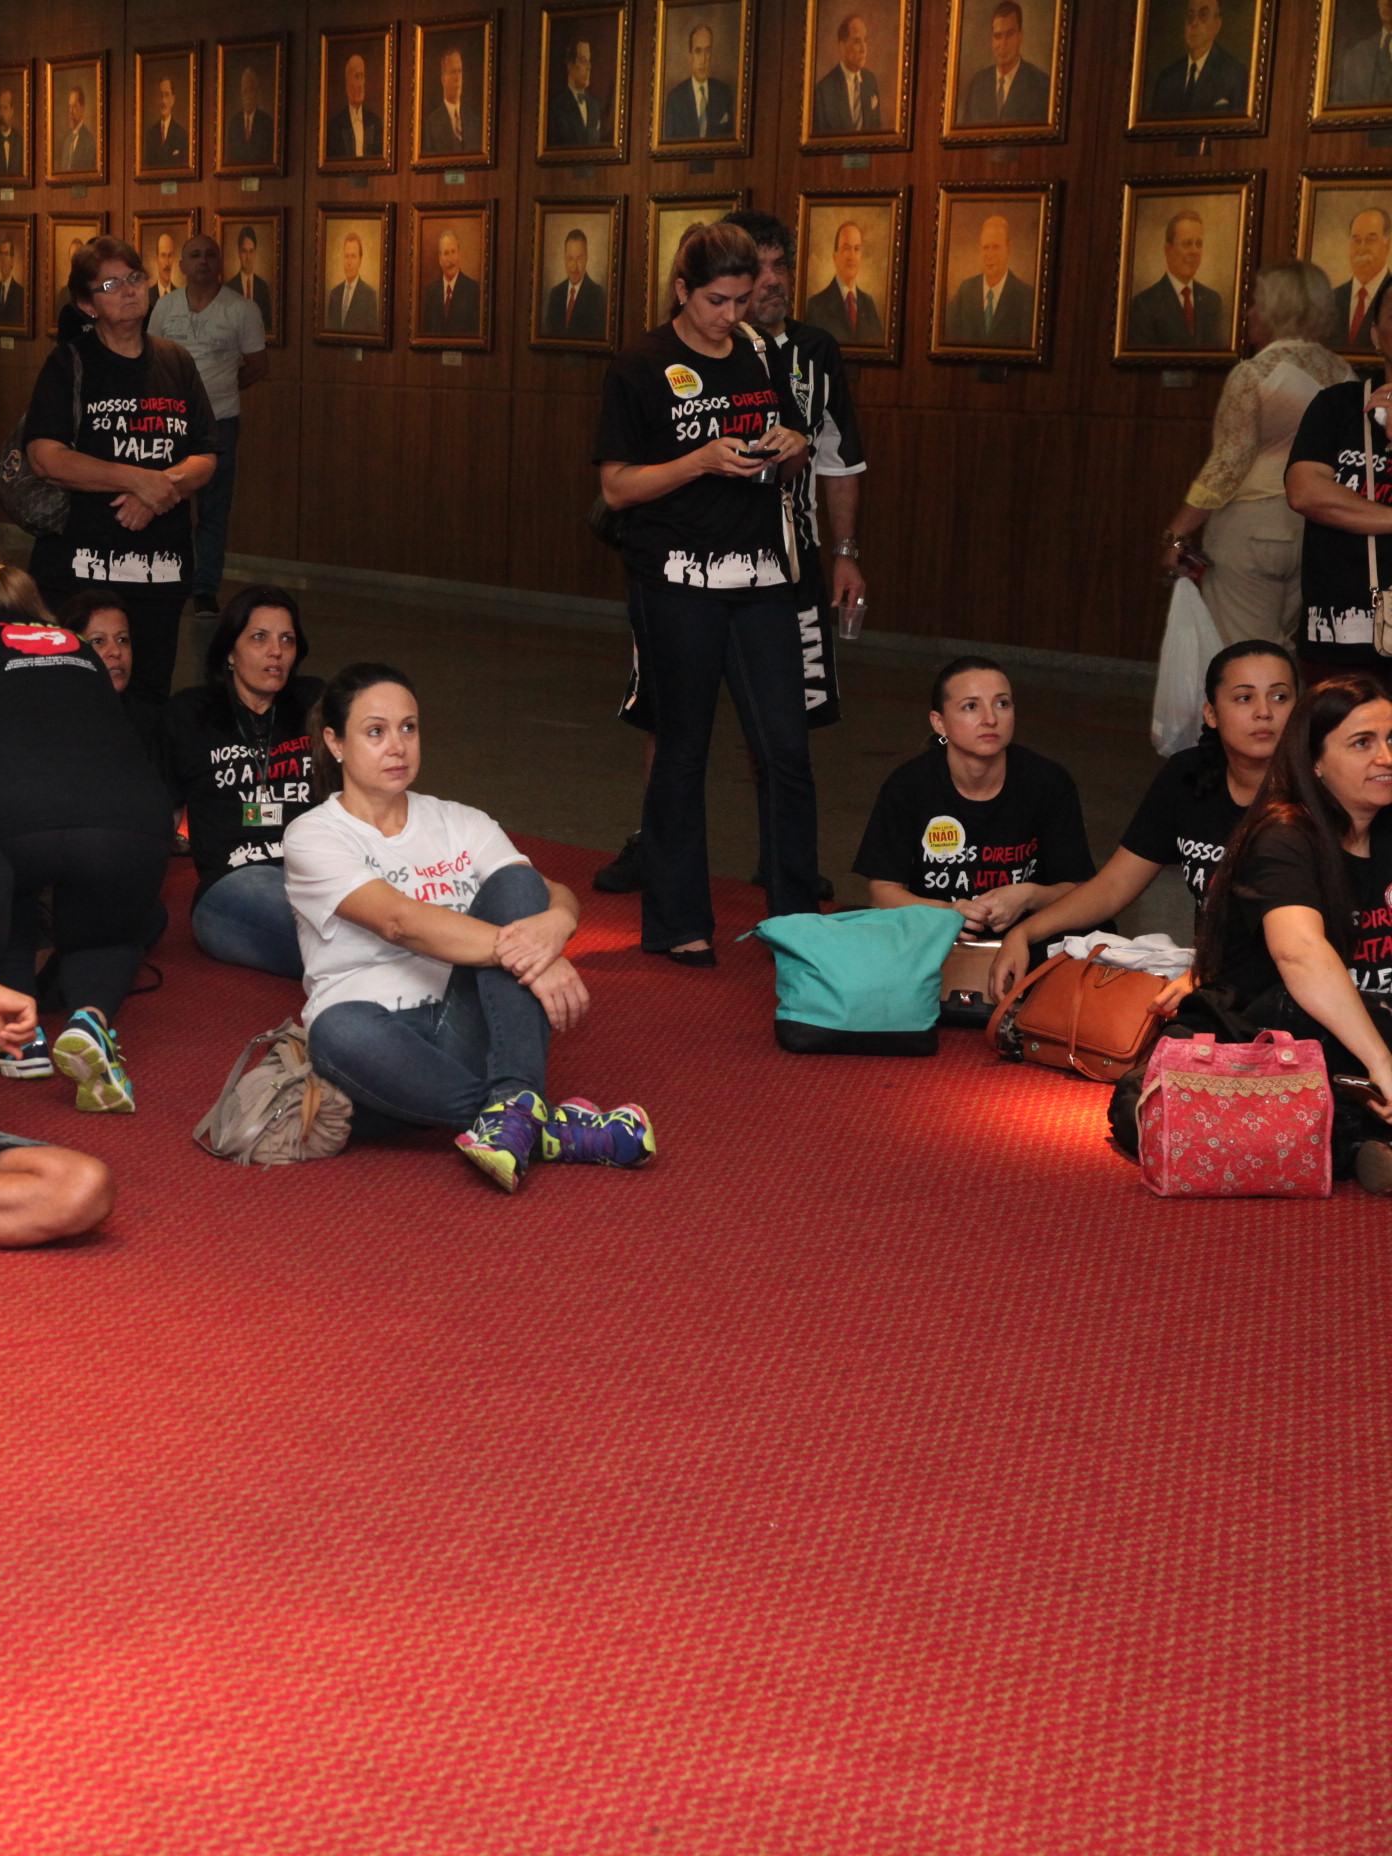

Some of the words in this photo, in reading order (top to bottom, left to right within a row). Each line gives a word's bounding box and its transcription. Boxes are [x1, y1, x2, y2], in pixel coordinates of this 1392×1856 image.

[87, 398, 138, 415] NOSSOS
[671, 396, 730, 421] NOSSOS
[92, 413, 112, 431] SÓ
[116, 415, 127, 434] A
[129, 416, 165, 434] LUTA
[166, 417, 188, 436] FAZ
[676, 415, 702, 442] SÓ
[707, 416, 720, 439] A
[722, 411, 764, 435] LUTA
[113, 436, 174, 463] VALER
[1345, 473, 1359, 492] A
[214, 761, 236, 789] SÓ
[241, 764, 253, 785] A
[1176, 836, 1226, 862] NOSSO
[924, 866, 950, 889] SÓ
[955, 870, 969, 892] A
[1192, 867, 1205, 892] A
